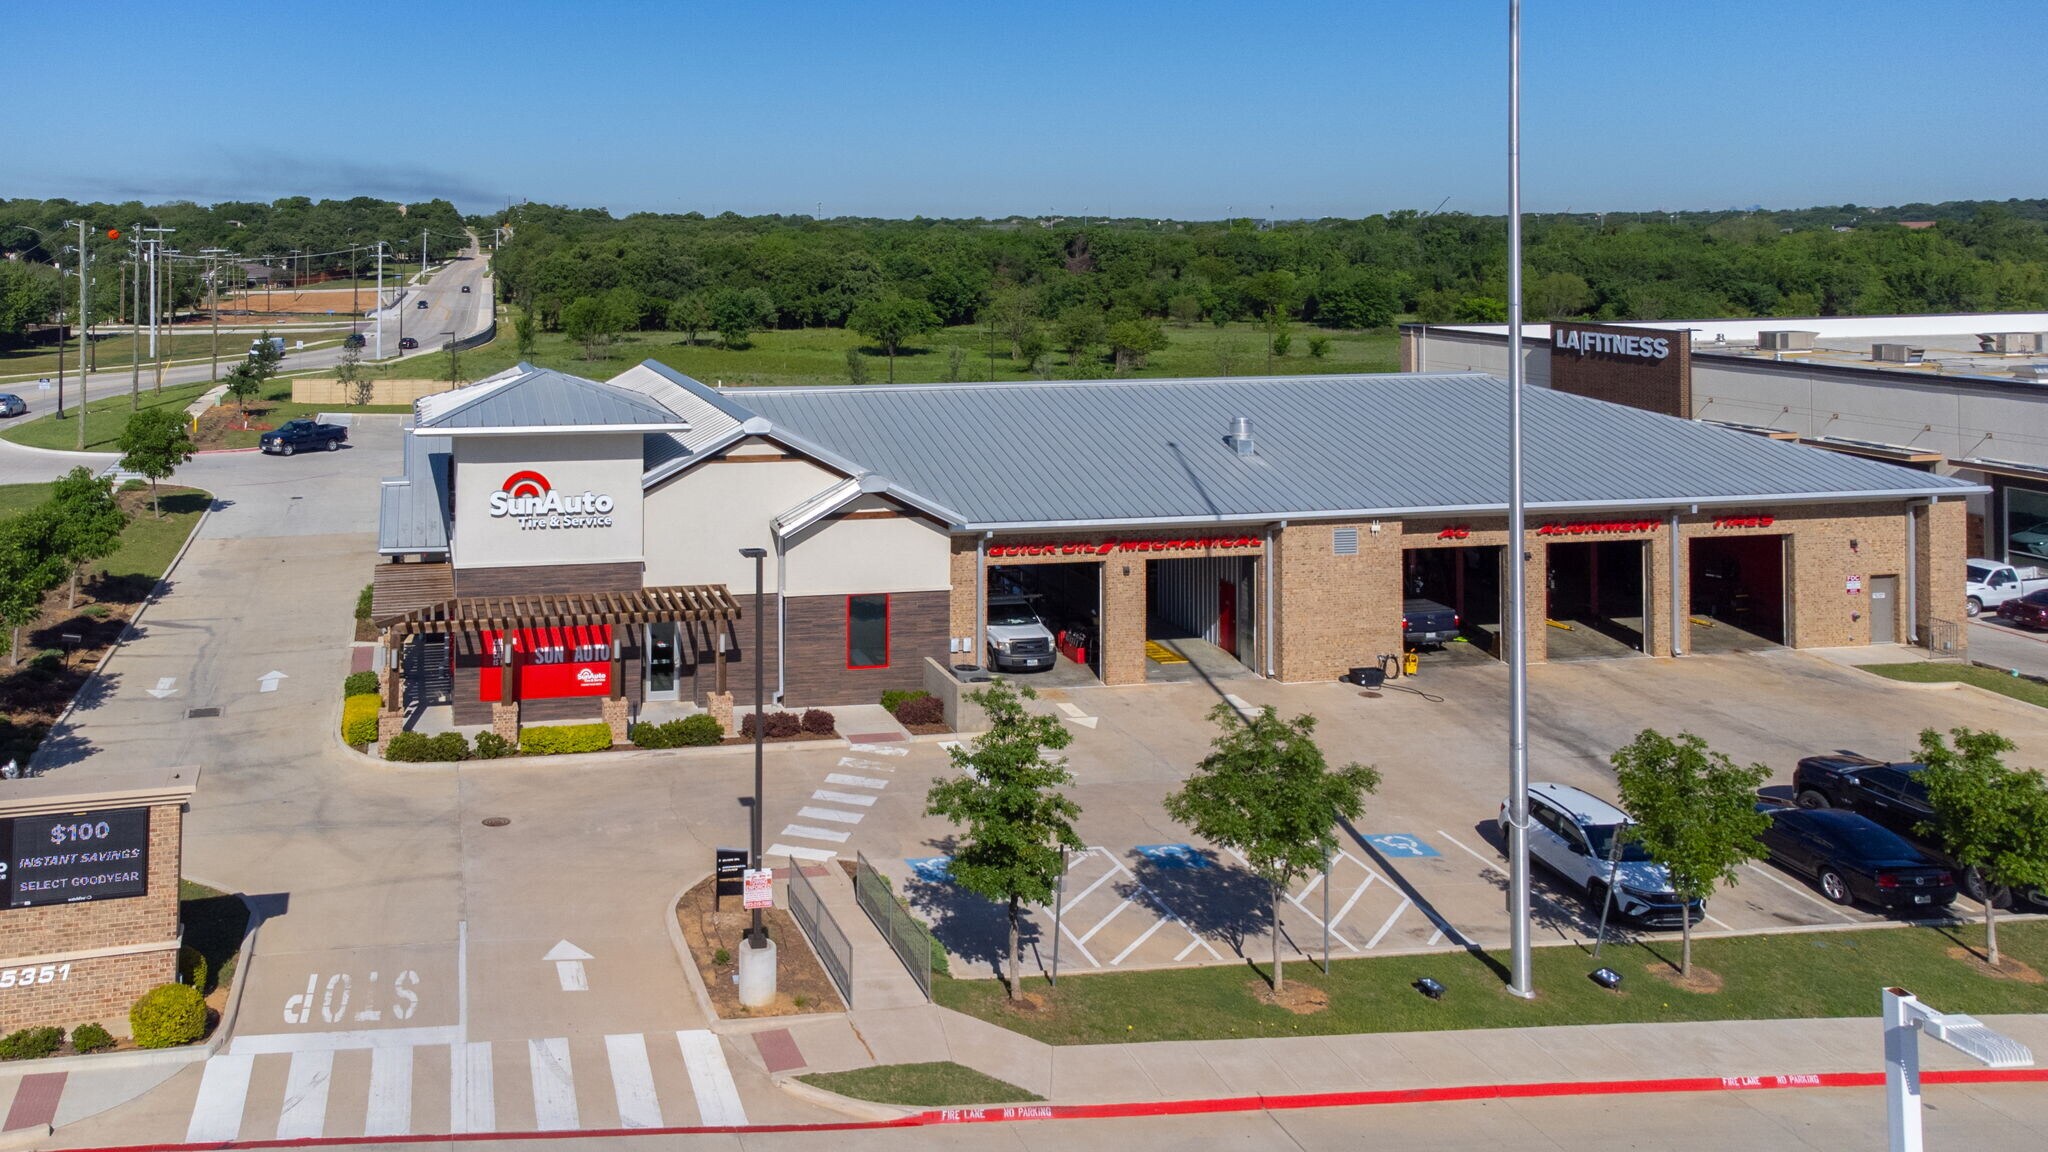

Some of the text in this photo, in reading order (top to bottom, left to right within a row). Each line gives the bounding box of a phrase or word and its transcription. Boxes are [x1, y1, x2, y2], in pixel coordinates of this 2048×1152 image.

[519, 513, 613, 530] Tire & Service
[988, 542, 1057, 557] QUICK
[535, 645, 565, 665] SUN
[574, 643, 611, 663] AUTO
[50, 821, 110, 845] $100
[19, 848, 140, 869] INSTANT SAVINGS
[20, 871, 139, 892] SELECT GOODYEAR
[0, 963, 71, 988] 5351
[283, 969, 420, 1024] STOP
[1722, 1074, 1820, 1087] FIRE LANE NO PARKING
[942, 1106, 1052, 1121] FIRE LANE NO PARKING
